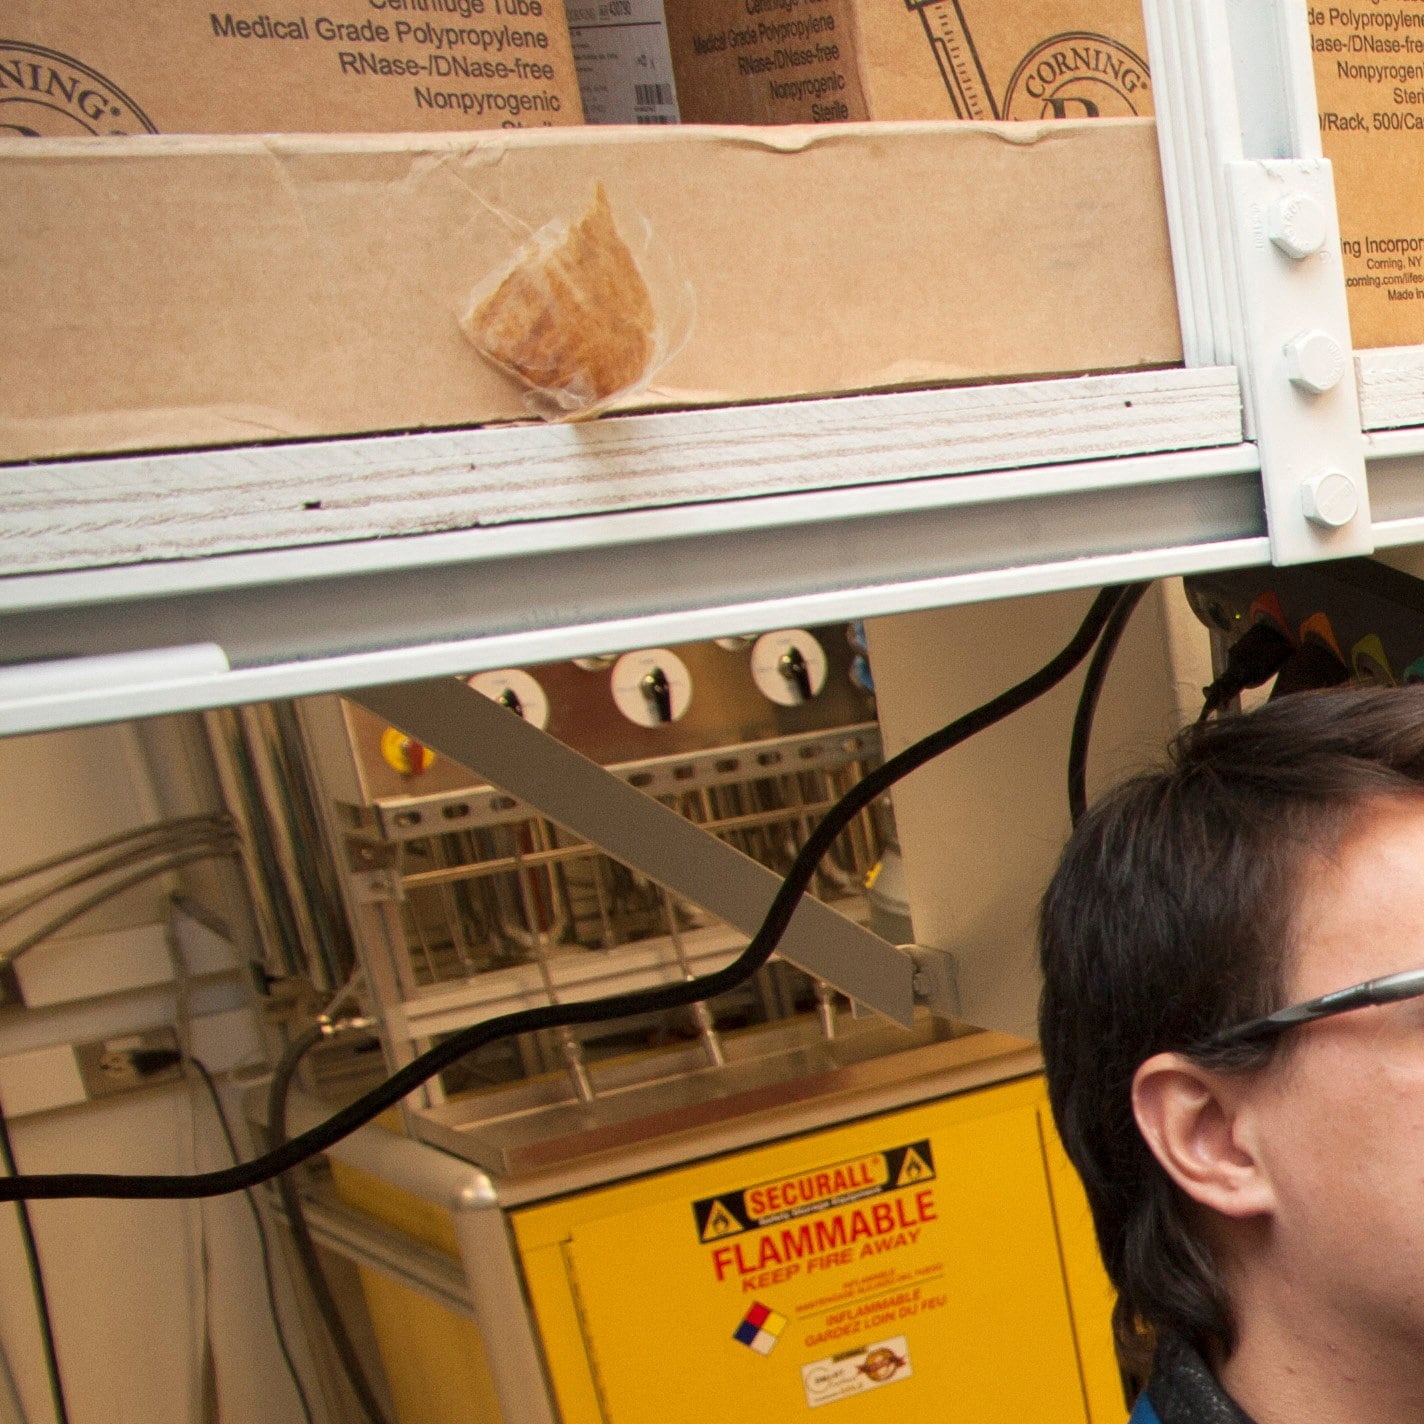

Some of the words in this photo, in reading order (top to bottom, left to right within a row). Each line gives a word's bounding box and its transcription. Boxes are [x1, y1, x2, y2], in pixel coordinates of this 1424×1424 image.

[209, 13, 309, 40] Medical
[315, 17, 390, 42] Grade
[395, 20, 548, 51] Polypropylene
[338, 52, 554, 80] RNase-/DNase-free
[1025, 47, 1141, 99] CORNING
[413, 86, 561, 114] Nonpyrogenic
[811, 101, 849, 122] Sterile
[1366, 257, 1406, 271] Corning,
[1408, 256, 1422, 268] NY
[1387, 288, 1414, 301] Made
[1416, 287, 1424, 299] in
[750, 1163, 876, 1216] SECURALL
[712, 1190, 938, 1281] FLAMMABLE
[742, 1264, 800, 1292] KEEP
[807, 1247, 852, 1273] FIRE
[860, 1228, 921, 1259] AWAY
